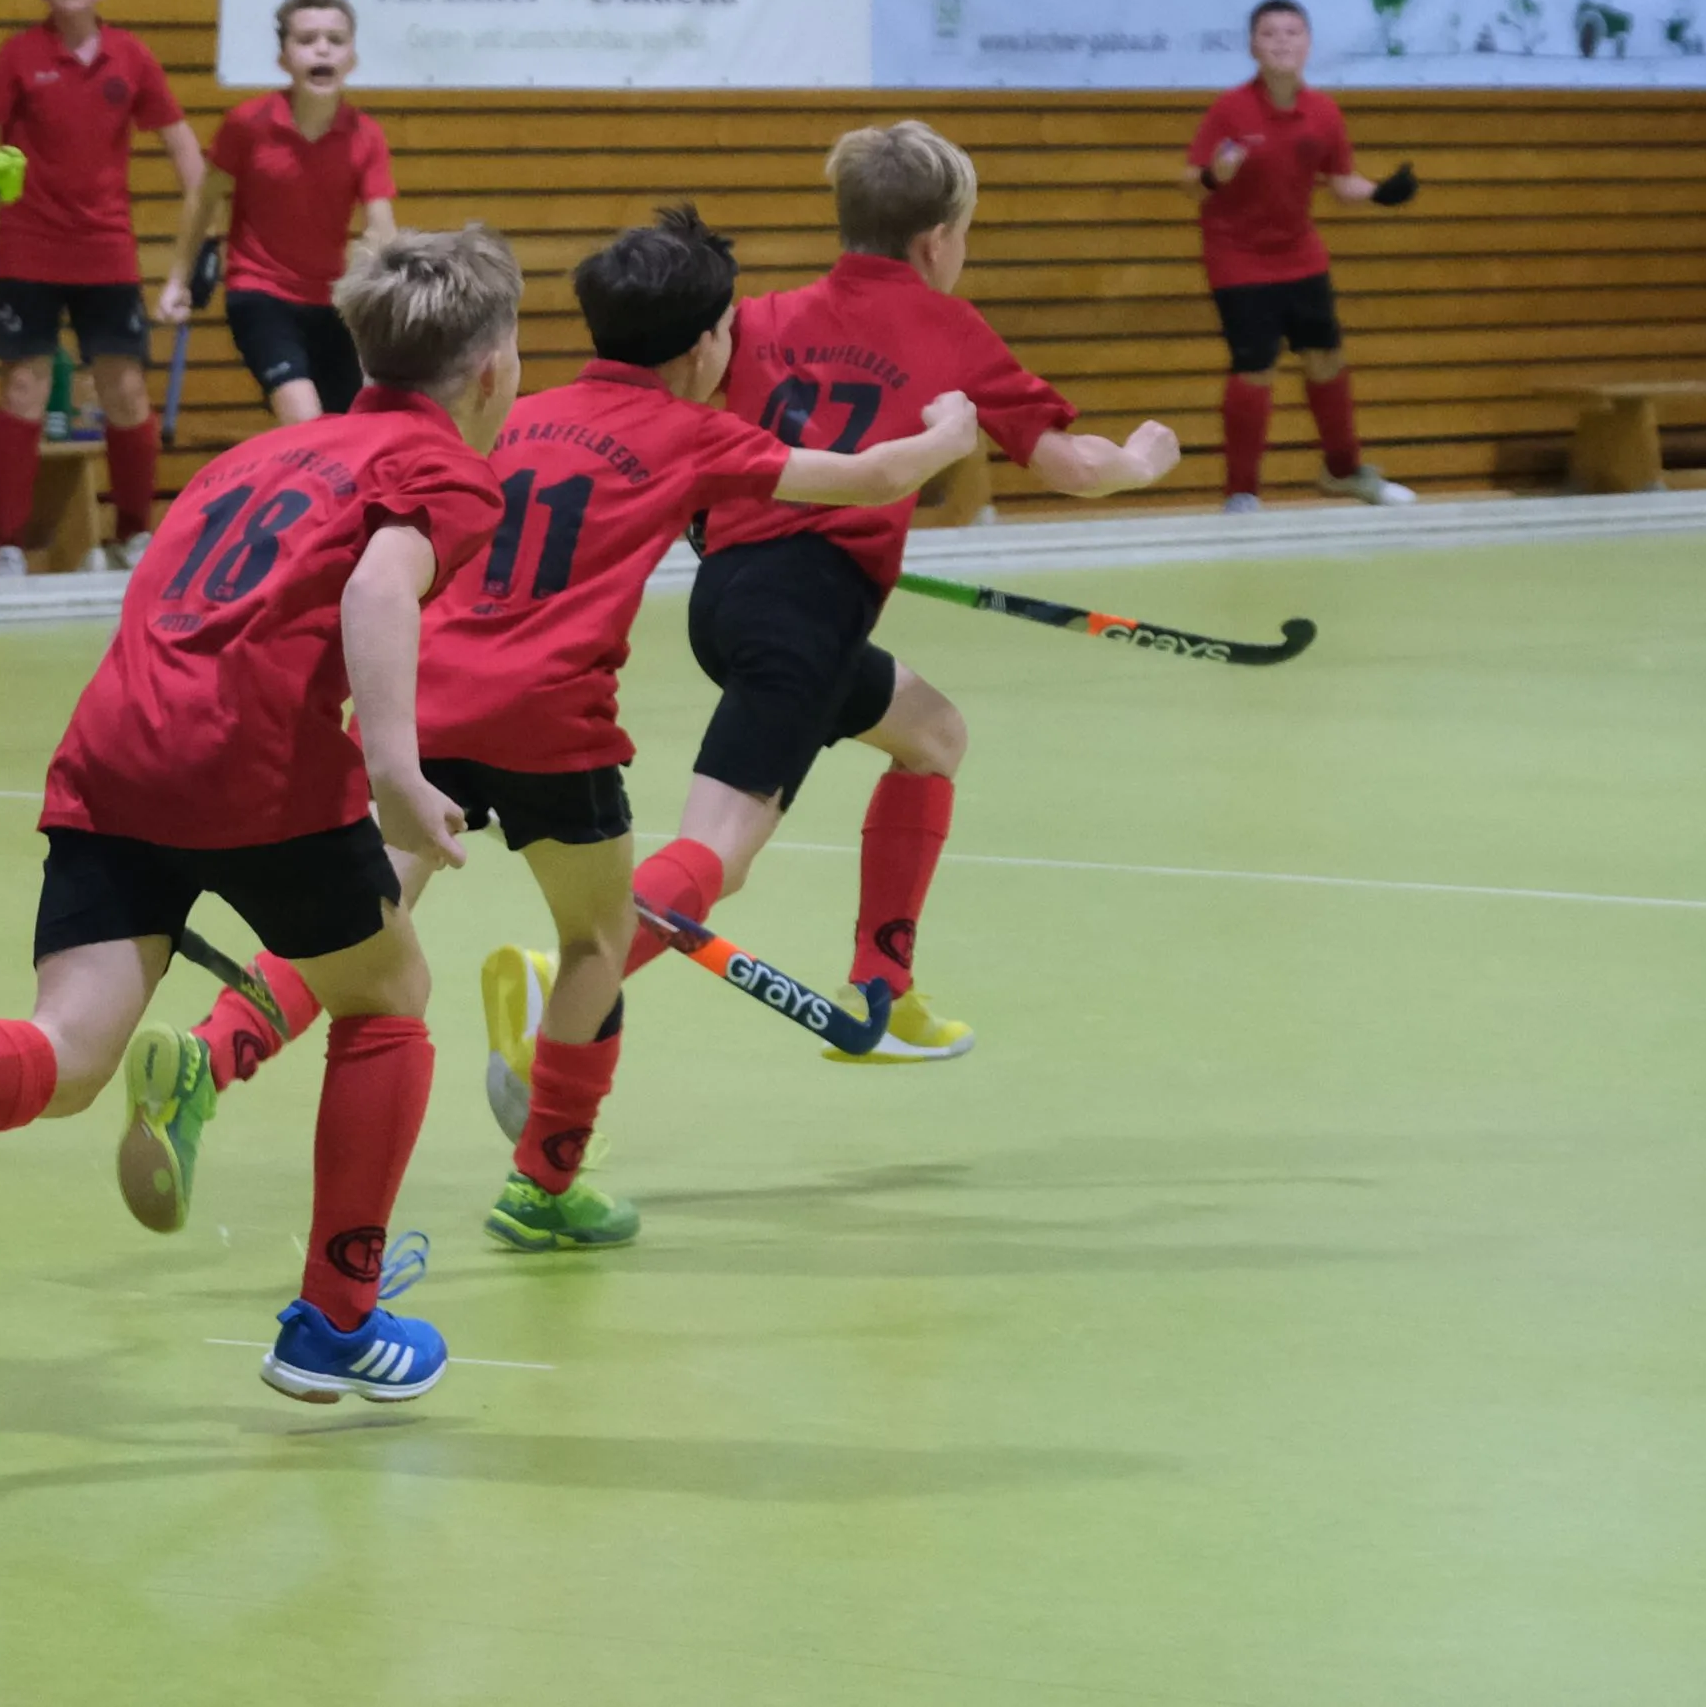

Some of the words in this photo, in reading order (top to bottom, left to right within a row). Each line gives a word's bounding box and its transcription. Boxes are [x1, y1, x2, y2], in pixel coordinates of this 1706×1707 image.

[803, 344, 910, 390] RAFFELBERG
[525, 422, 651, 486] RAFFELBERG
[162, 483, 312, 603] 18
[483, 468, 595, 600] 11
[725, 950, 833, 1032] Grays
